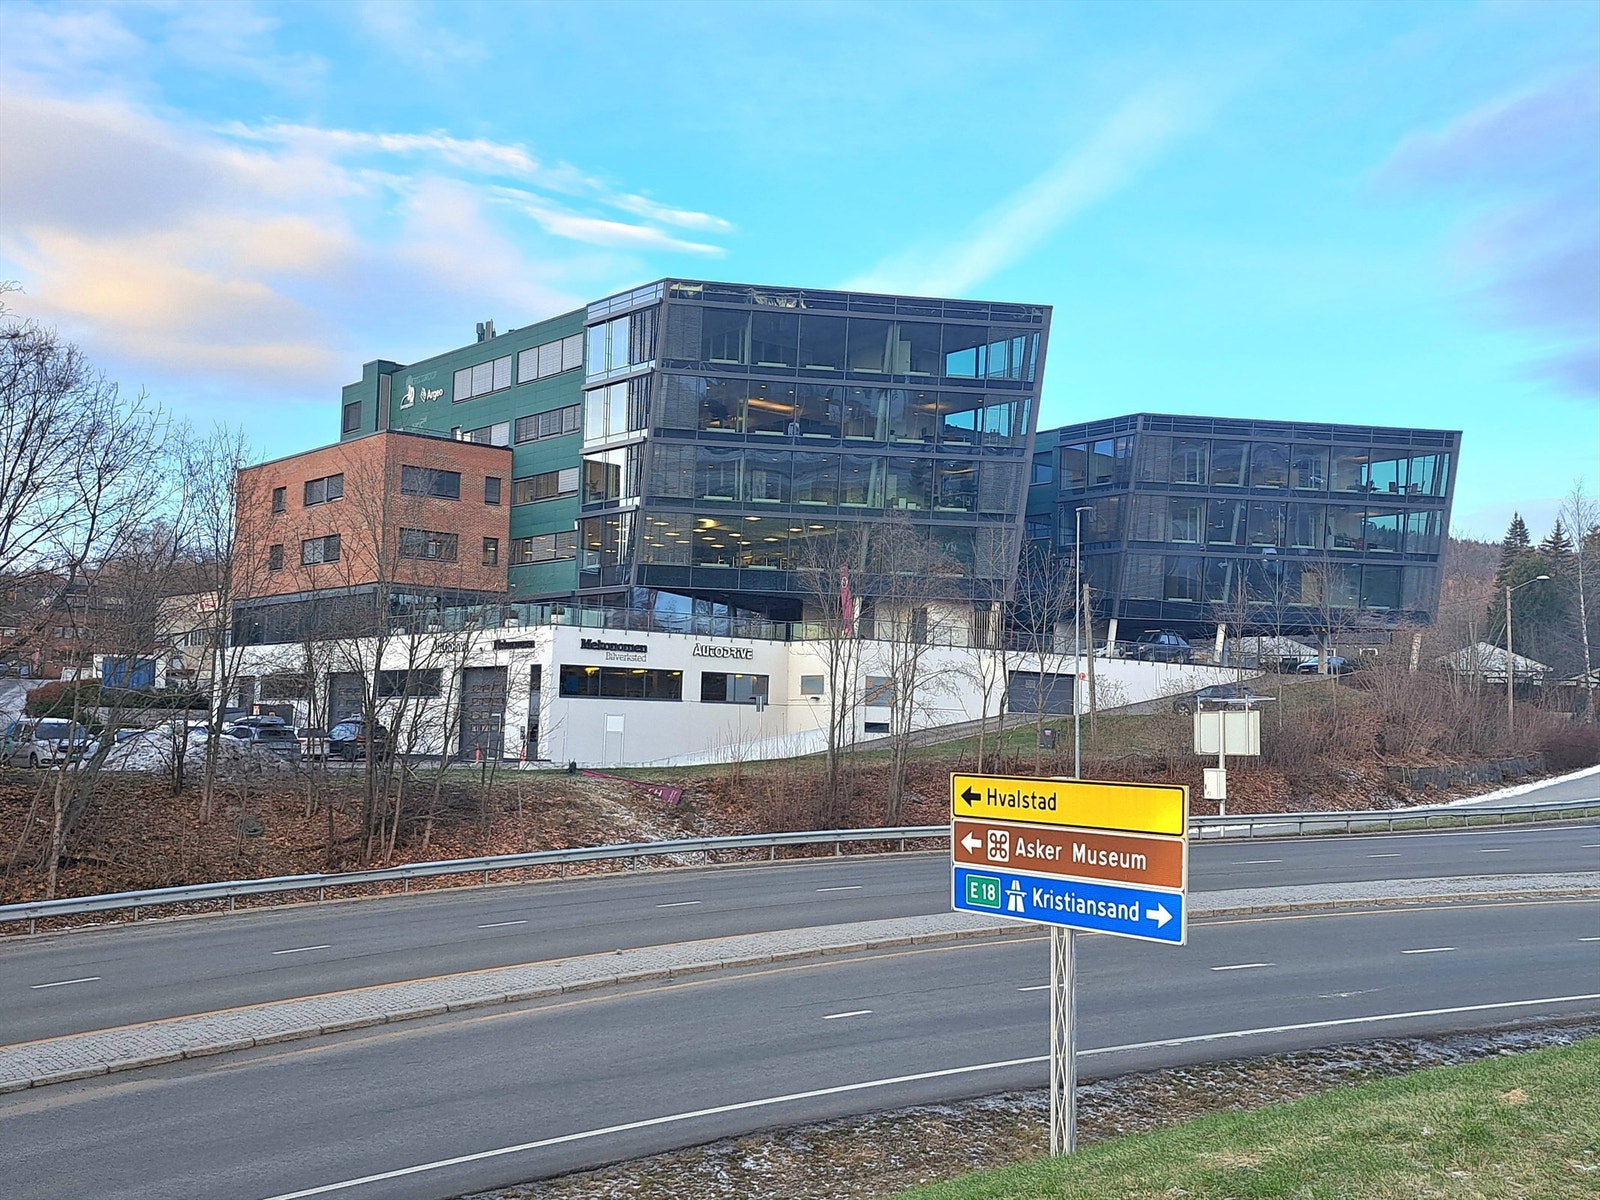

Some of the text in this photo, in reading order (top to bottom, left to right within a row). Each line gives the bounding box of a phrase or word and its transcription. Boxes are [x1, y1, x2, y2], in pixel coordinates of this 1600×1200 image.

[580, 638, 648, 653] Mekonomen
[692, 642, 753, 660] AUTODRIVE
[987, 787, 1057, 811] Hvalstad
[1015, 837, 1147, 870] Asker Museum
[970, 881, 997, 901] E 18
[1032, 887, 1140, 922] Kristiansand
